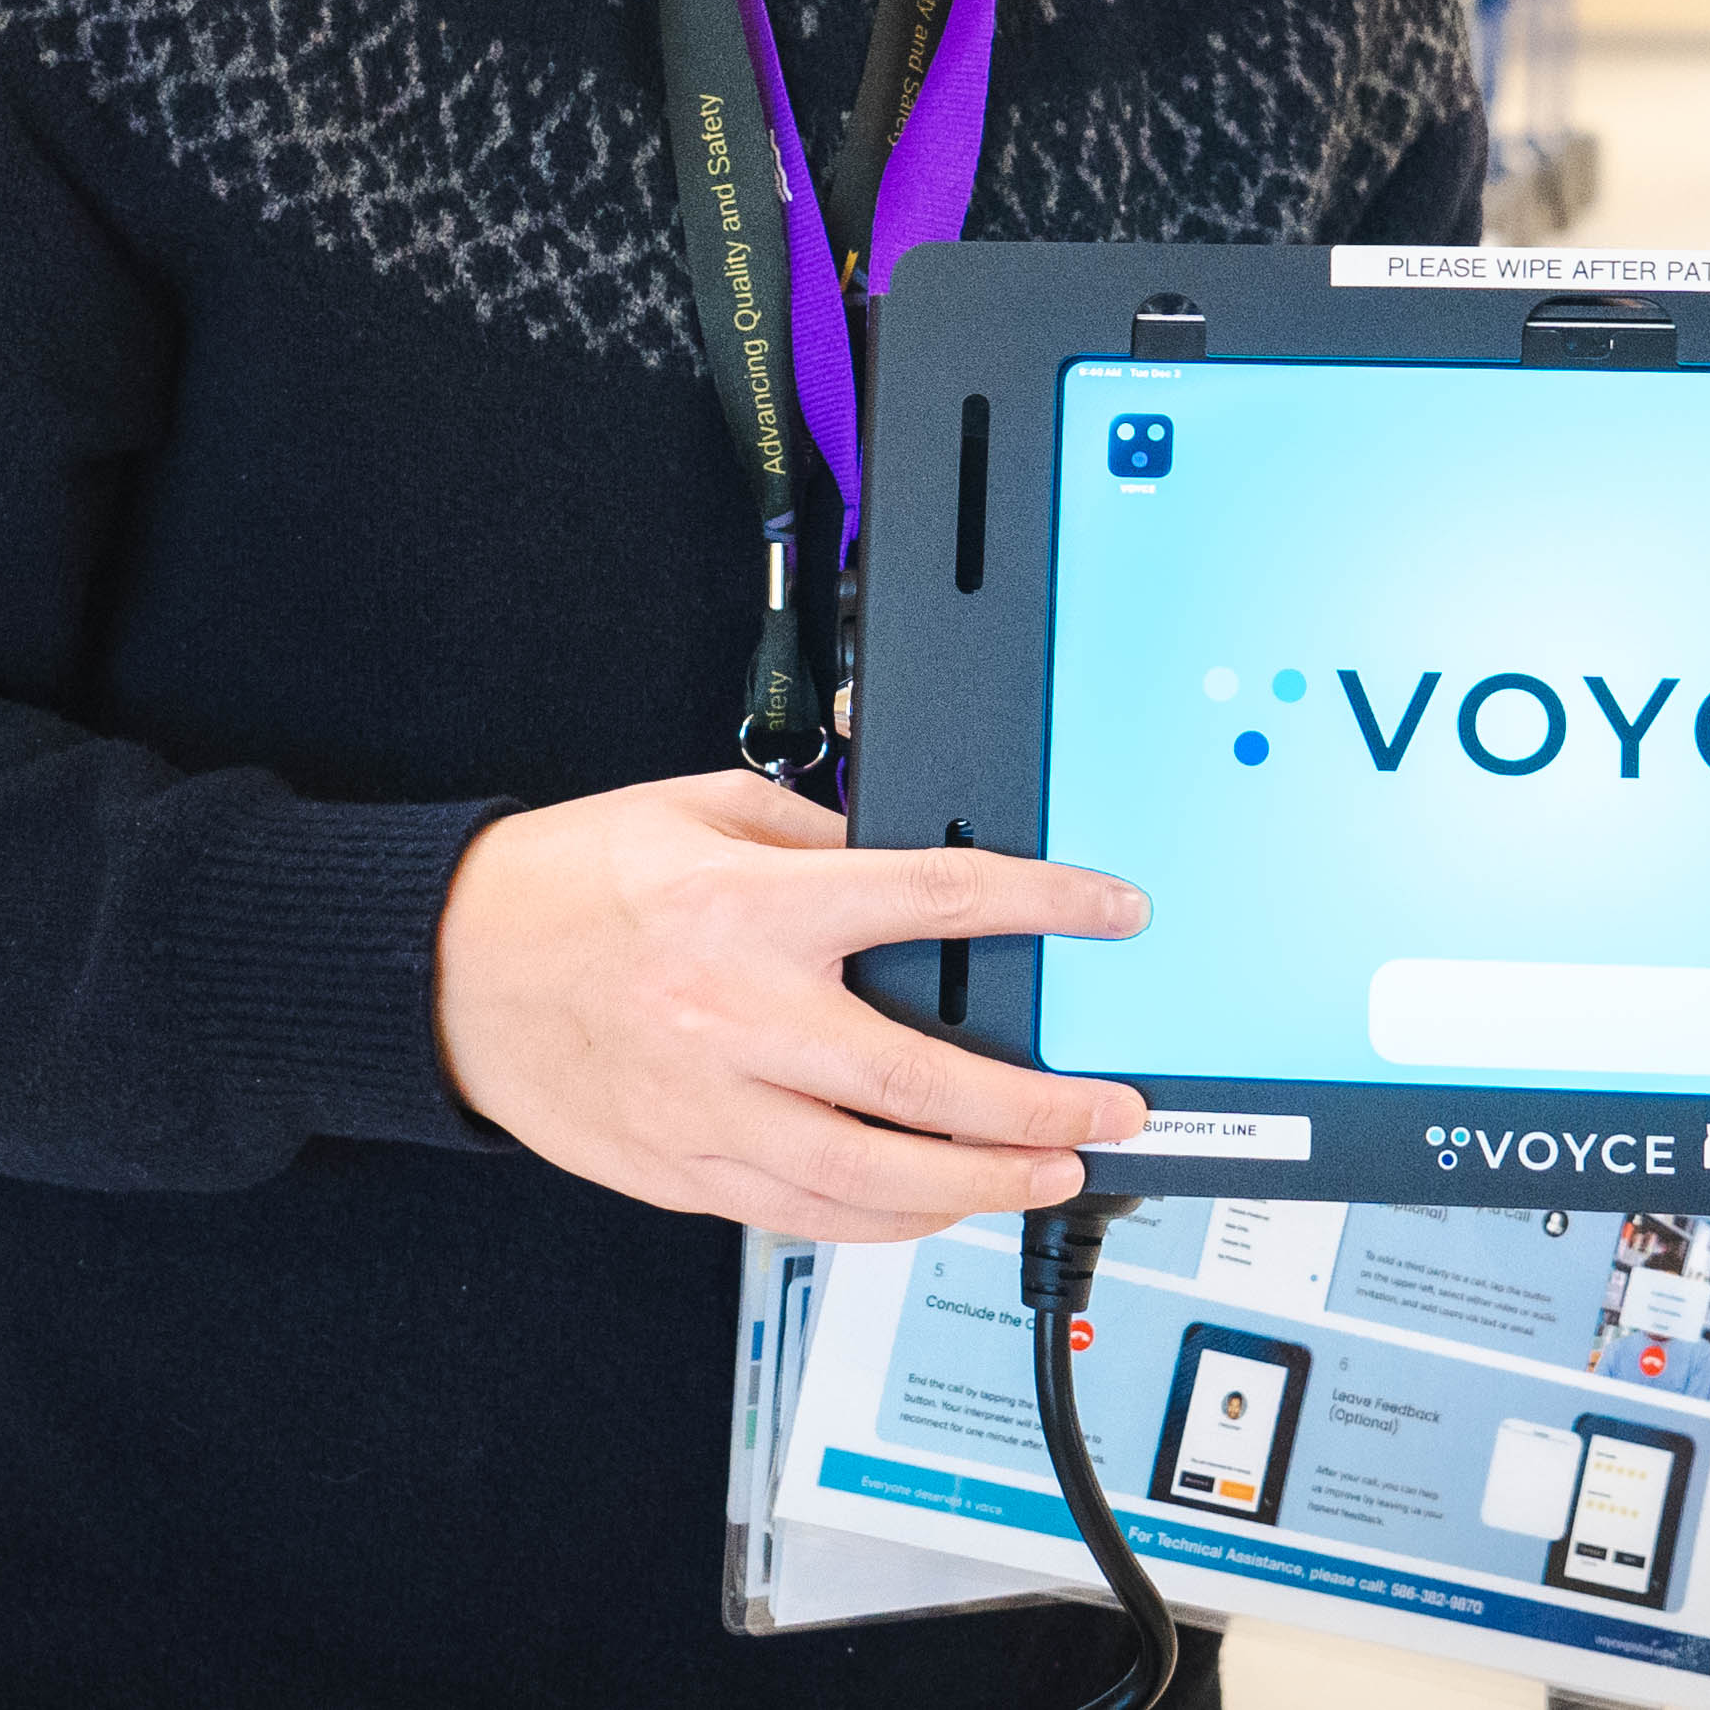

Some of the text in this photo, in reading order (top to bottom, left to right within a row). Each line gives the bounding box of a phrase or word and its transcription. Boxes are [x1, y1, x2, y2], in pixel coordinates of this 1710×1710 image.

[908, 25, 929, 73] and
[699, 93, 786, 475] Advancing Quality and Safety
[1388, 257, 1487, 279] PLEASE
[1497, 259, 1563, 280] WIPE
[1572, 260, 1657, 282] AFTER
[766, 671, 793, 731] afety
[1143, 1120, 1258, 1136] SUPPORT LINE
[1474, 1129, 1676, 1176] VOYCE
[1378, 1203, 1449, 1223] ptional)
[933, 1262, 944, 1277] 5
[926, 1295, 996, 1321] Conclude
[998, 1311, 1021, 1328] the
[1339, 1357, 1349, 1371] 6
[908, 1373, 1035, 1410] End the call by tapping the
[1332, 1388, 1441, 1423] Leave Feedback
[904, 1393, 937, 1408] button.
[940, 1400, 961, 1413] Your
[965, 1405, 1014, 1425] interpreter
[1015, 1415, 1032, 1428] will
[1328, 1404, 1400, 1436] (Optional)
[900, 1412, 1043, 1451] reconnect for one minute after
[860, 1475, 911, 1496] Everyone
[1127, 1525, 1154, 1544] For
[1157, 1531, 1223, 1560] Technical
[1225, 1547, 1306, 1579] Assistance,
[1309, 1566, 1355, 1590] please
[1358, 1577, 1387, 1595] call:
